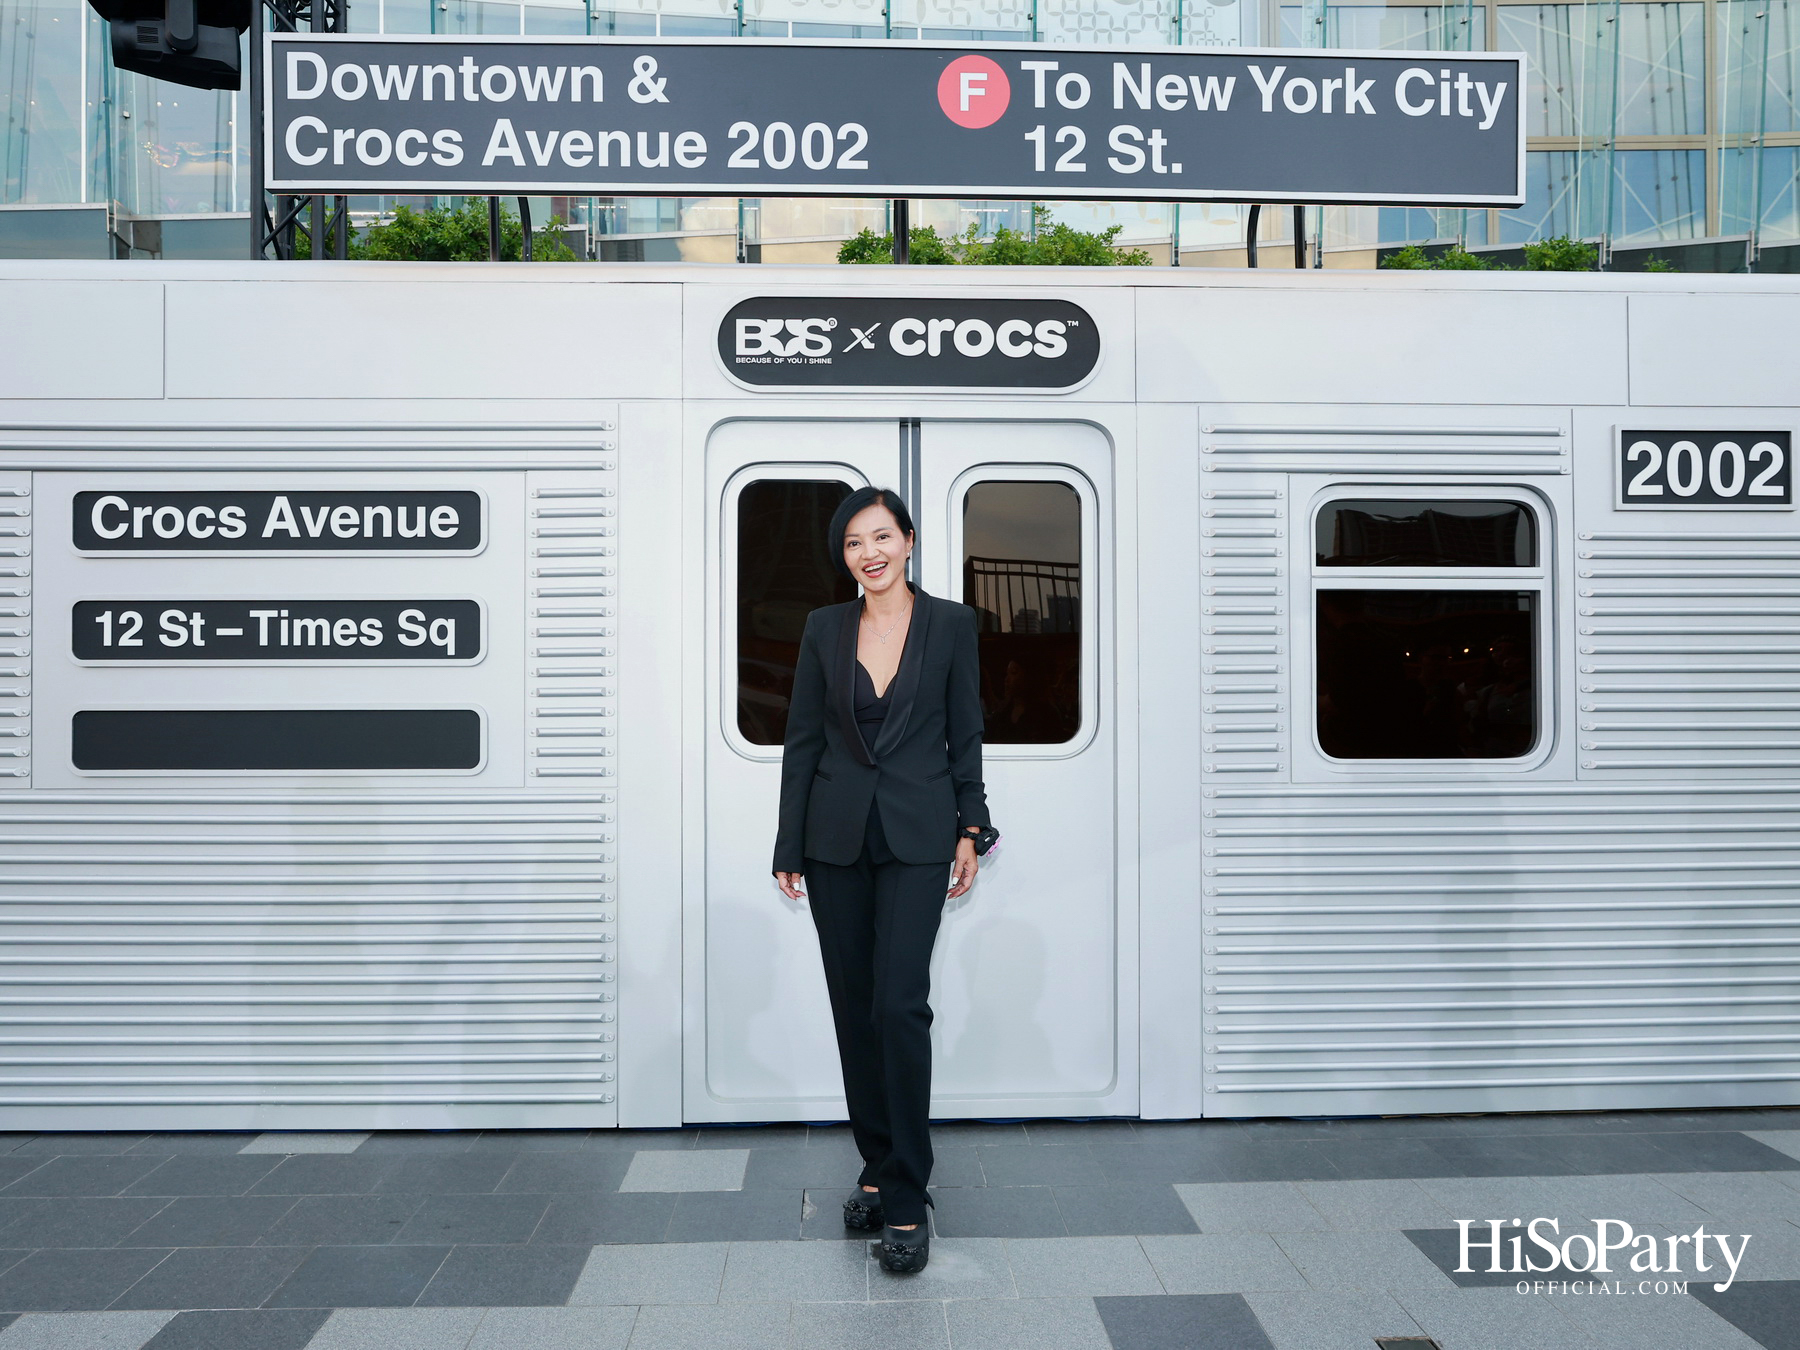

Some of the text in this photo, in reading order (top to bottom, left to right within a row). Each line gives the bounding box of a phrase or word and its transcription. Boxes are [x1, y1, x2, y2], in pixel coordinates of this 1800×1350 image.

[286, 51, 669, 104] Downtown &
[958, 73, 987, 111] F
[1020, 61, 1508, 131] To New York City
[285, 115, 869, 171] Crocs Avenue 2002
[1024, 124, 1183, 175] 12 St.
[808, 357, 832, 365] SHINE
[1627, 440, 1785, 498] 2002
[91, 495, 460, 540] Crocs Avenue
[95, 610, 144, 647] 12
[158, 609, 206, 647] St
[249, 609, 384, 647] Times
[397, 608, 456, 656] Sq
